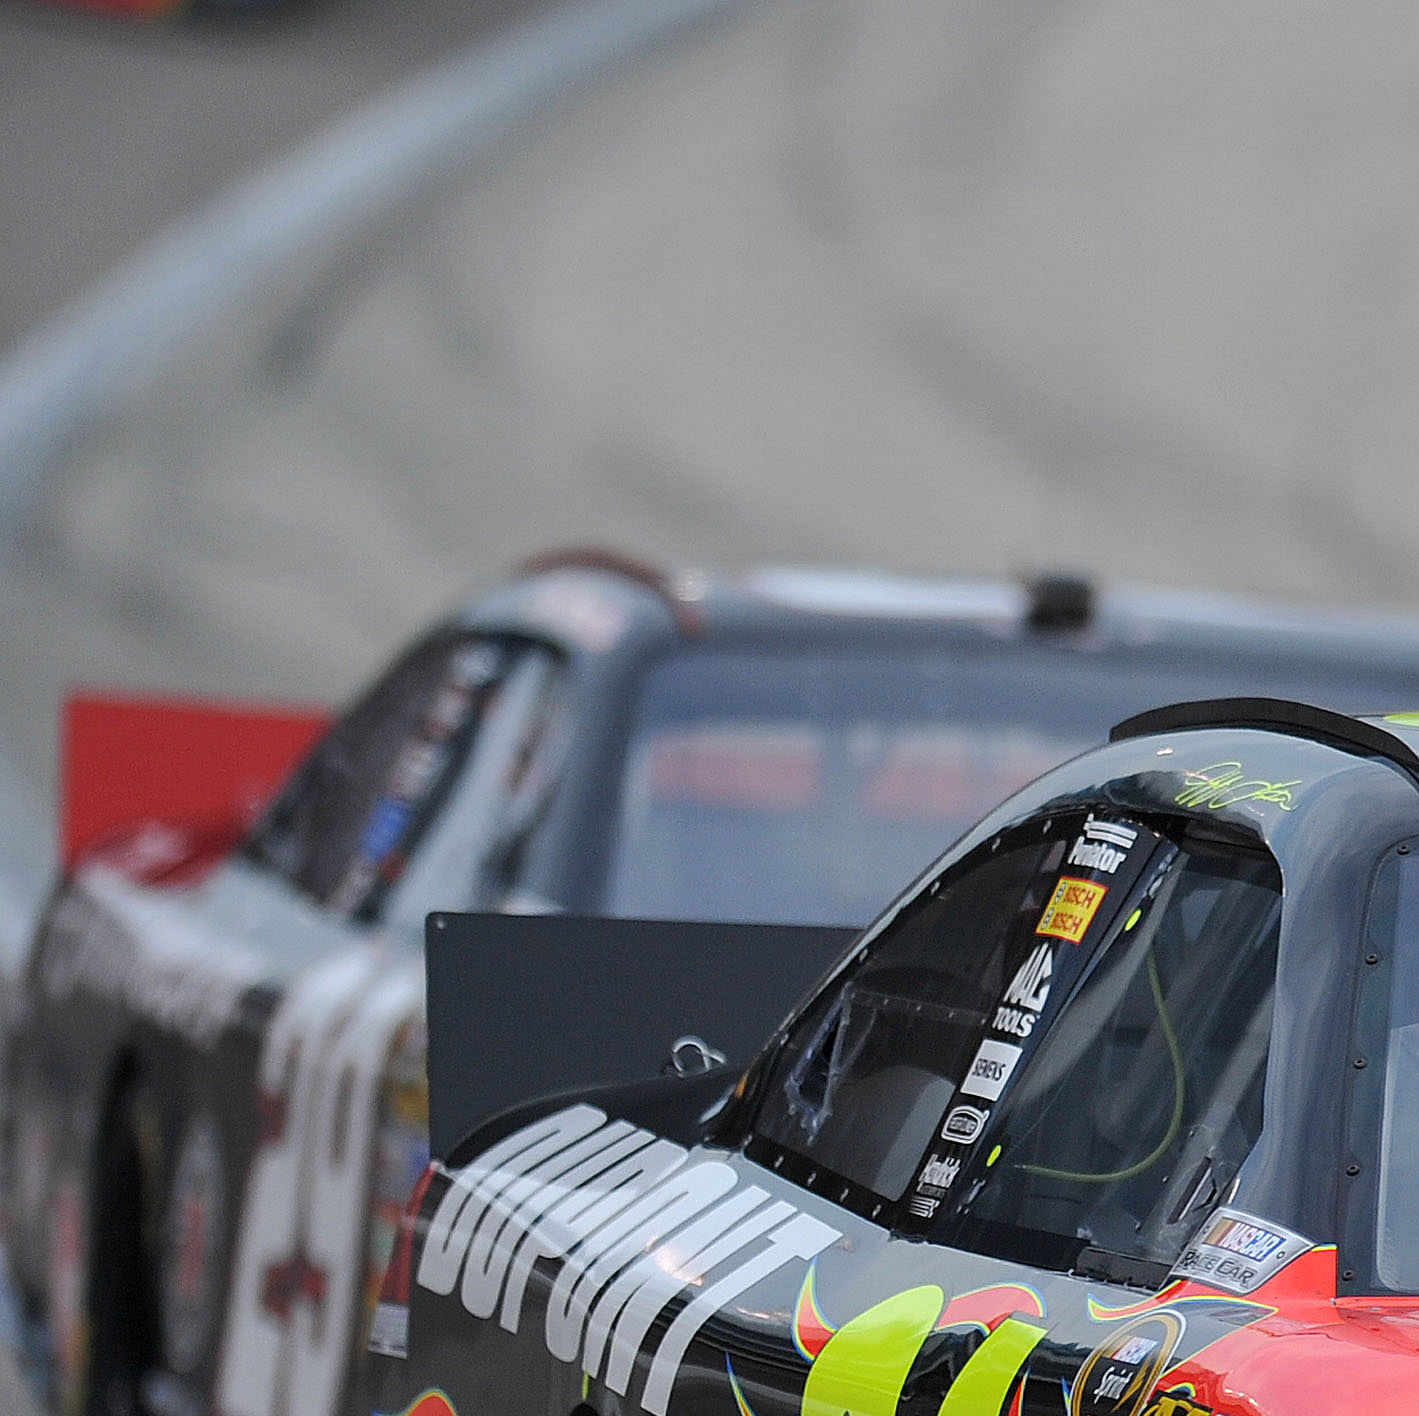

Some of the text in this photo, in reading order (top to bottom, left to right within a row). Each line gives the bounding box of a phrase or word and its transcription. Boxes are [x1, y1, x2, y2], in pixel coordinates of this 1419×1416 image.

[992, 1006, 1036, 1038] TOOLS
[1215, 1220, 1287, 1263] NASCAR
[1215, 1258, 1257, 1285] CAR
[1093, 1366, 1134, 1405] Sprint
